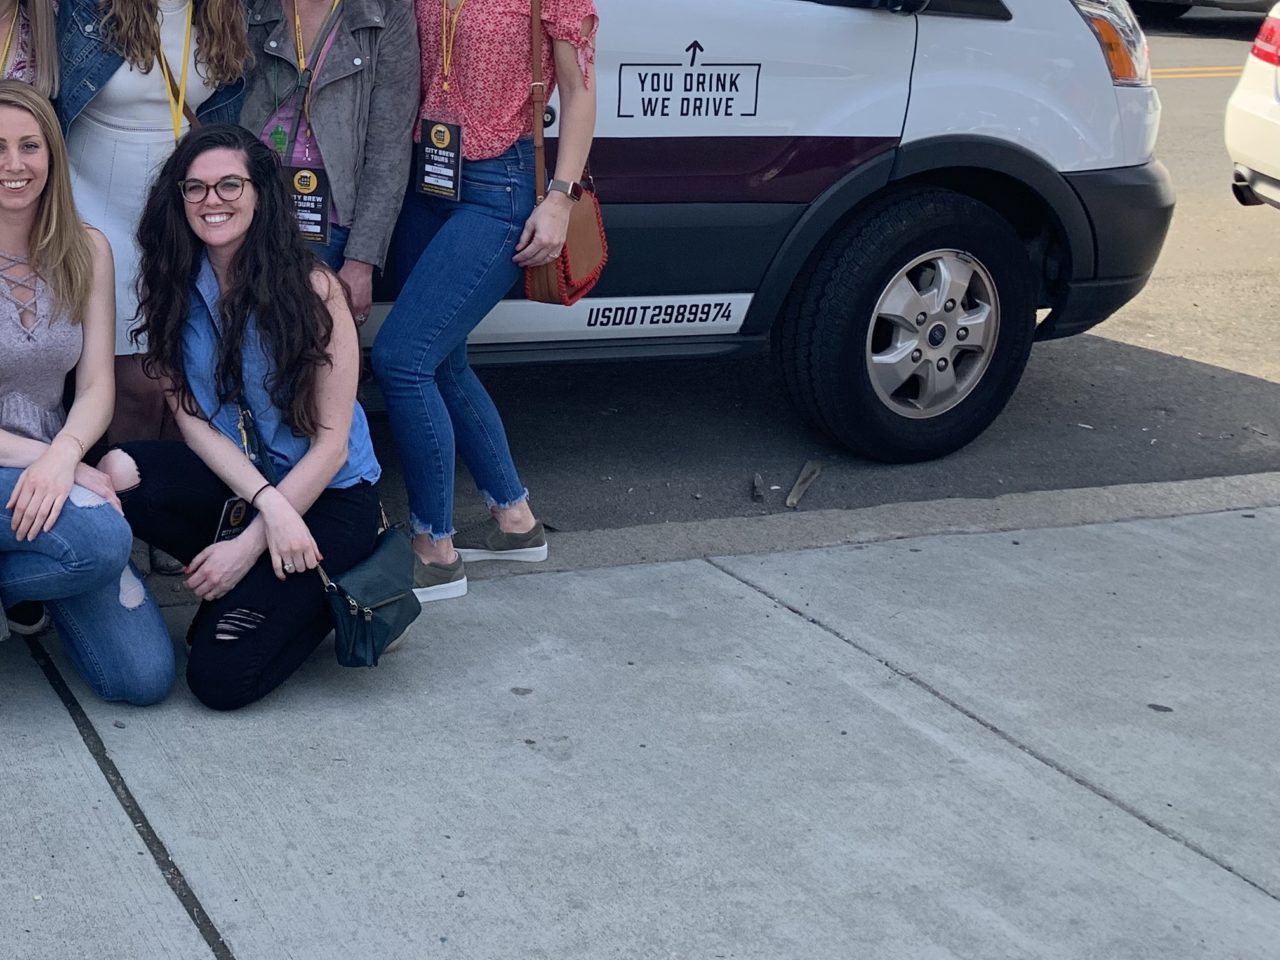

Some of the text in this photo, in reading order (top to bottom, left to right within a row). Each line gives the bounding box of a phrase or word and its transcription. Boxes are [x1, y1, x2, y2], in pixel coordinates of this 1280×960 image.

[638, 72, 741, 93] YOU DRINK
[641, 97, 735, 117] WE DRIVE
[586, 302, 733, 328] USDOT2989974
